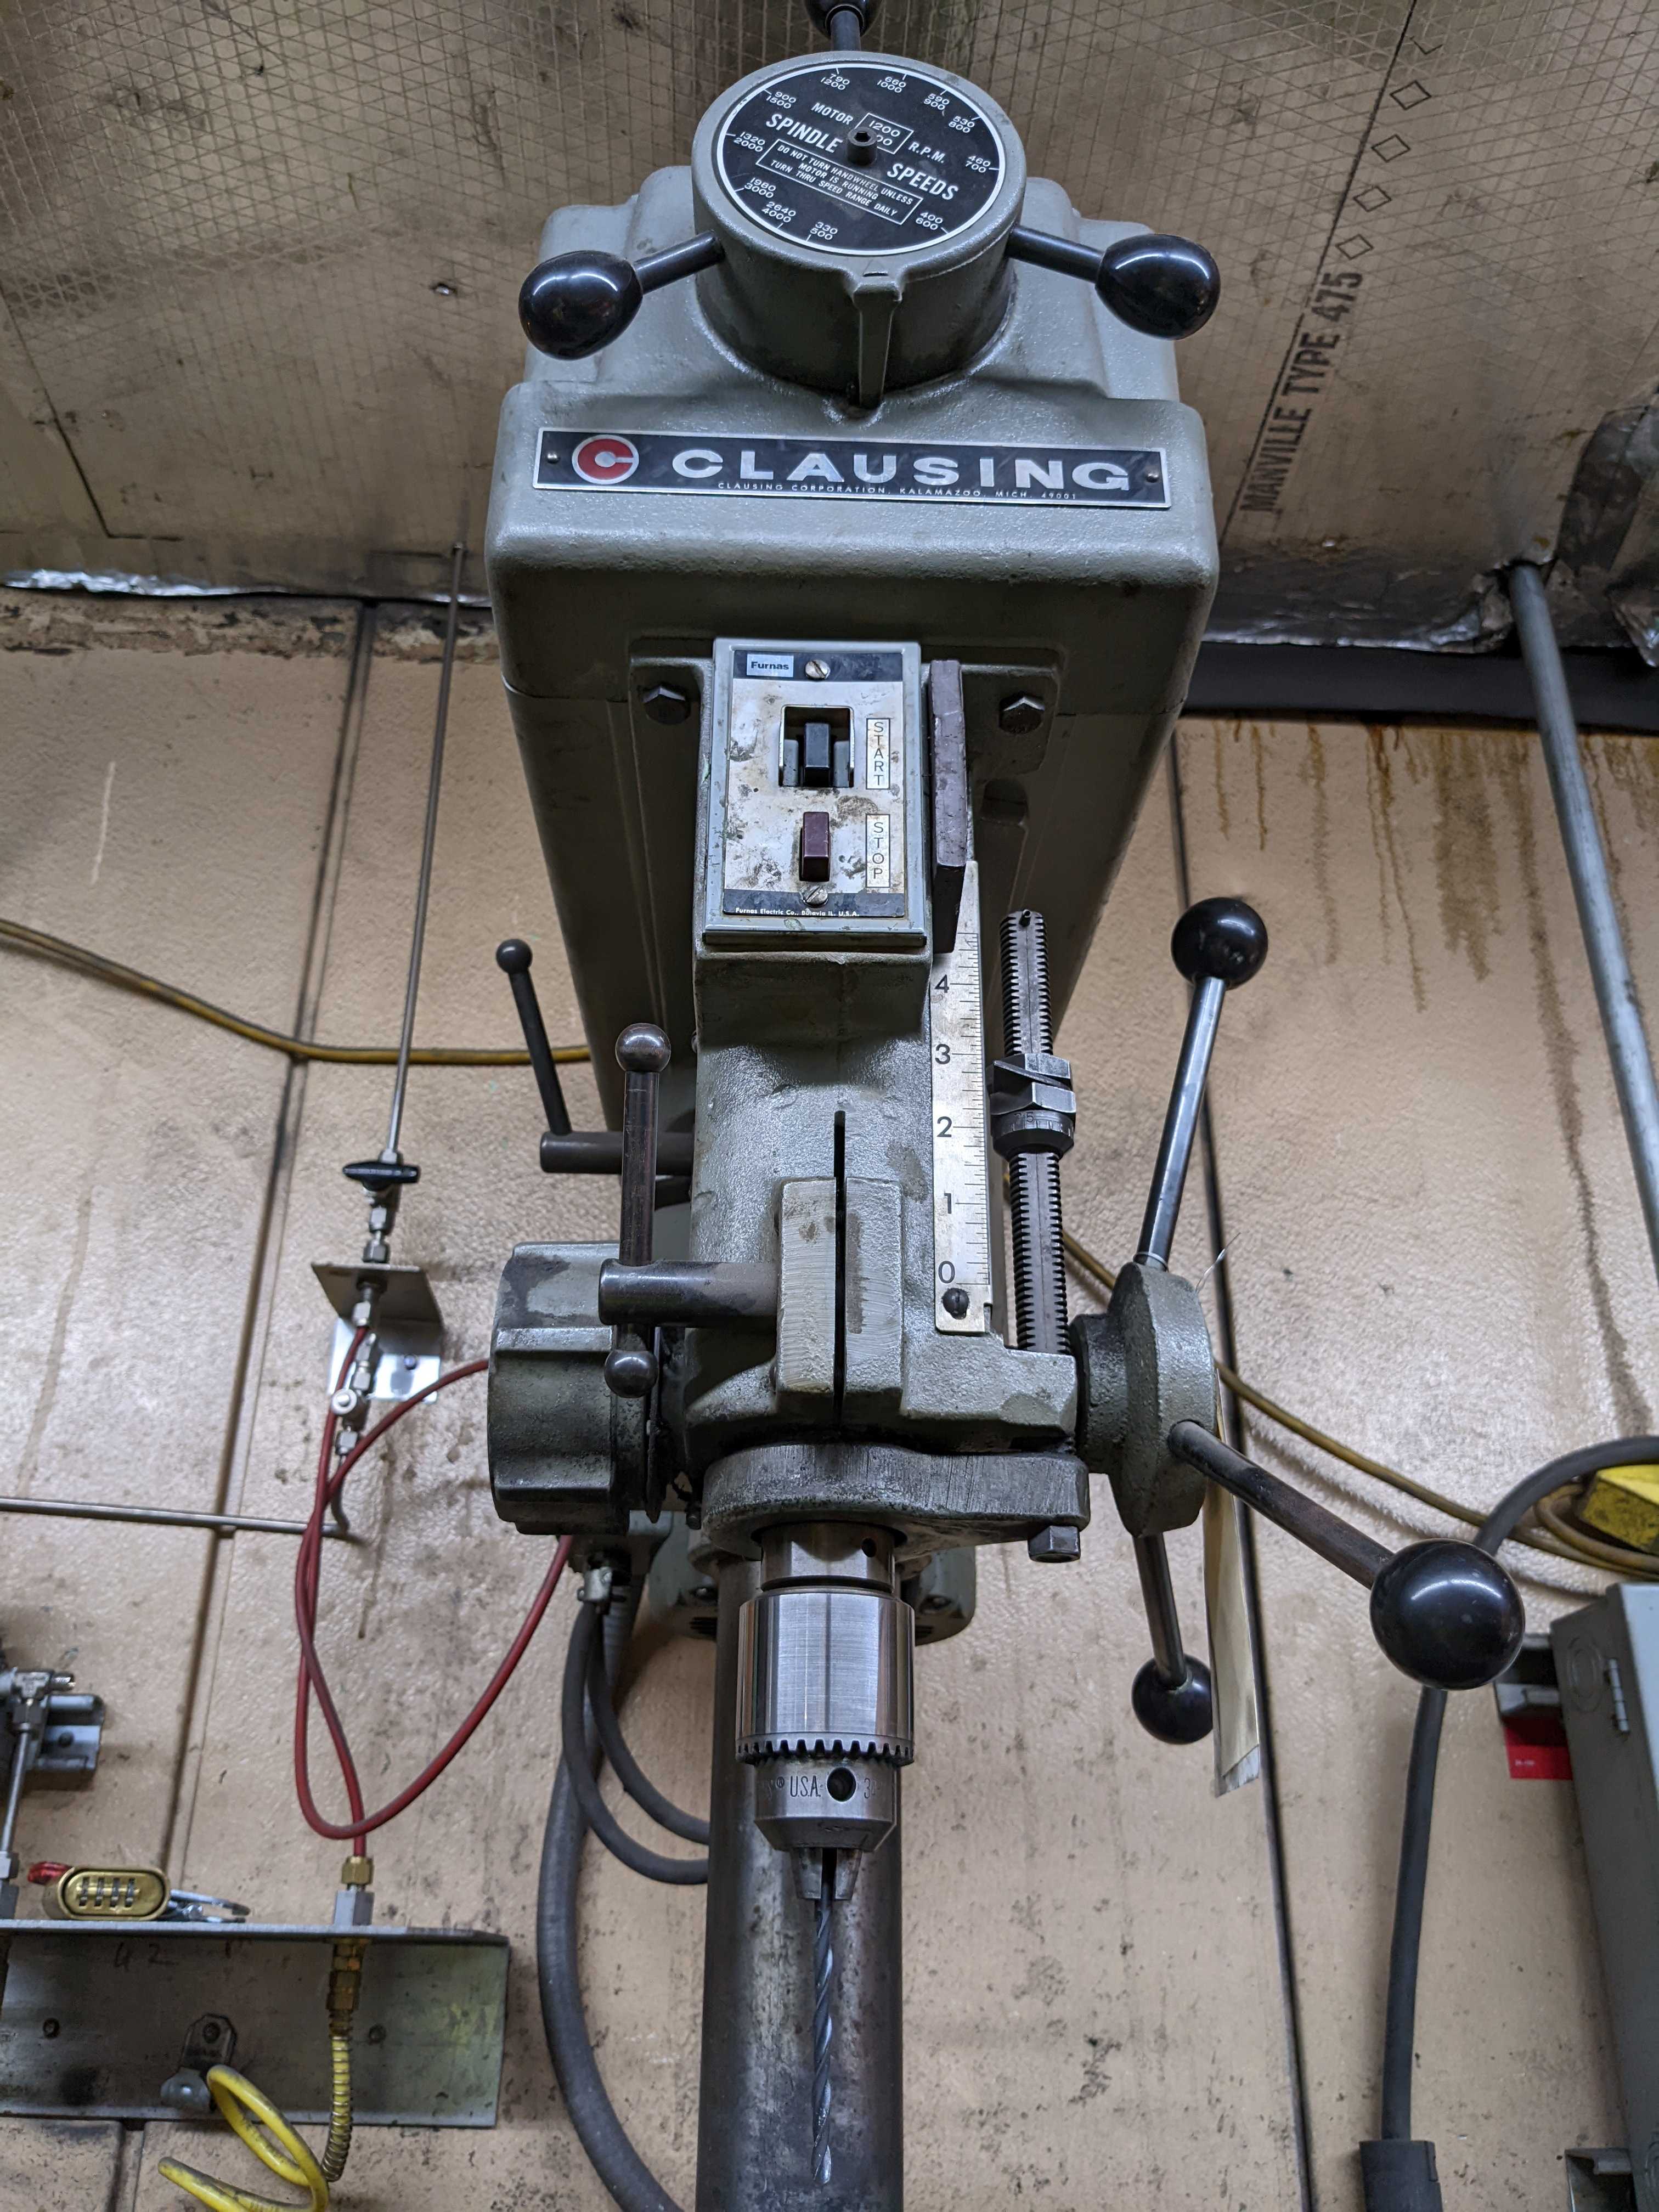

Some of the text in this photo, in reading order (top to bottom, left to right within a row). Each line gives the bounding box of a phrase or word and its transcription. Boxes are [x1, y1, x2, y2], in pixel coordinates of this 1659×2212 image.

[821, 77, 846, 91] 1200
[830, 73, 851, 86] 790
[877, 80, 902, 93] 1000
[884, 76, 906, 88] 660
[766, 95, 792, 109] 1500
[775, 91, 797, 103] 900
[923, 98, 945, 110] 900
[928, 93, 950, 105] 590
[811, 102, 854, 126] MOTOR
[868, 120, 901, 137] 1200
[948, 121, 970, 133] 800
[953, 116, 975, 128] 530
[740, 132, 765, 145] 1320
[766, 114, 843, 153] SPINDLE
[733, 137, 763, 152] 2000
[908, 141, 946, 163] R.P.M.
[965, 161, 986, 173] 700
[968, 155, 991, 167] 460
[777, 145, 913, 205] DO NOT TURN HANDWHEEL UNLESS
[798, 162, 878, 200] MOTOR IS RUNNING
[887, 163, 959, 200] SPEEDS
[744, 183, 774, 198] 3000
[749, 177, 776, 191] 1980
[770, 160, 898, 217] TURN THRU SPEED RANGE DAILY
[761, 208, 791, 223] 4000
[766, 201, 797, 217] 2640
[915, 217, 939, 230] 600
[919, 212, 944, 224] 400
[810, 228, 833, 240] 500
[815, 222, 838, 234] 330
[1311, 272, 1363, 323] 475
[1282, 332, 1341, 396] TYPE
[672, 448, 1130, 490] CLAUSING
[718, 482, 784, 490] CLAUSING
[1042, 492, 1076, 500] 49001
[751, 661, 789, 671] Furnas
[873, 721, 884, 787] START
[872, 822, 884, 880] STOP
[934, 974, 950, 994] 4
[935, 1045, 951, 1064] 3
[936, 1116, 953, 1137] 2
[943, 1193, 952, 1214] 1
[938, 1261, 956, 1284] 0
